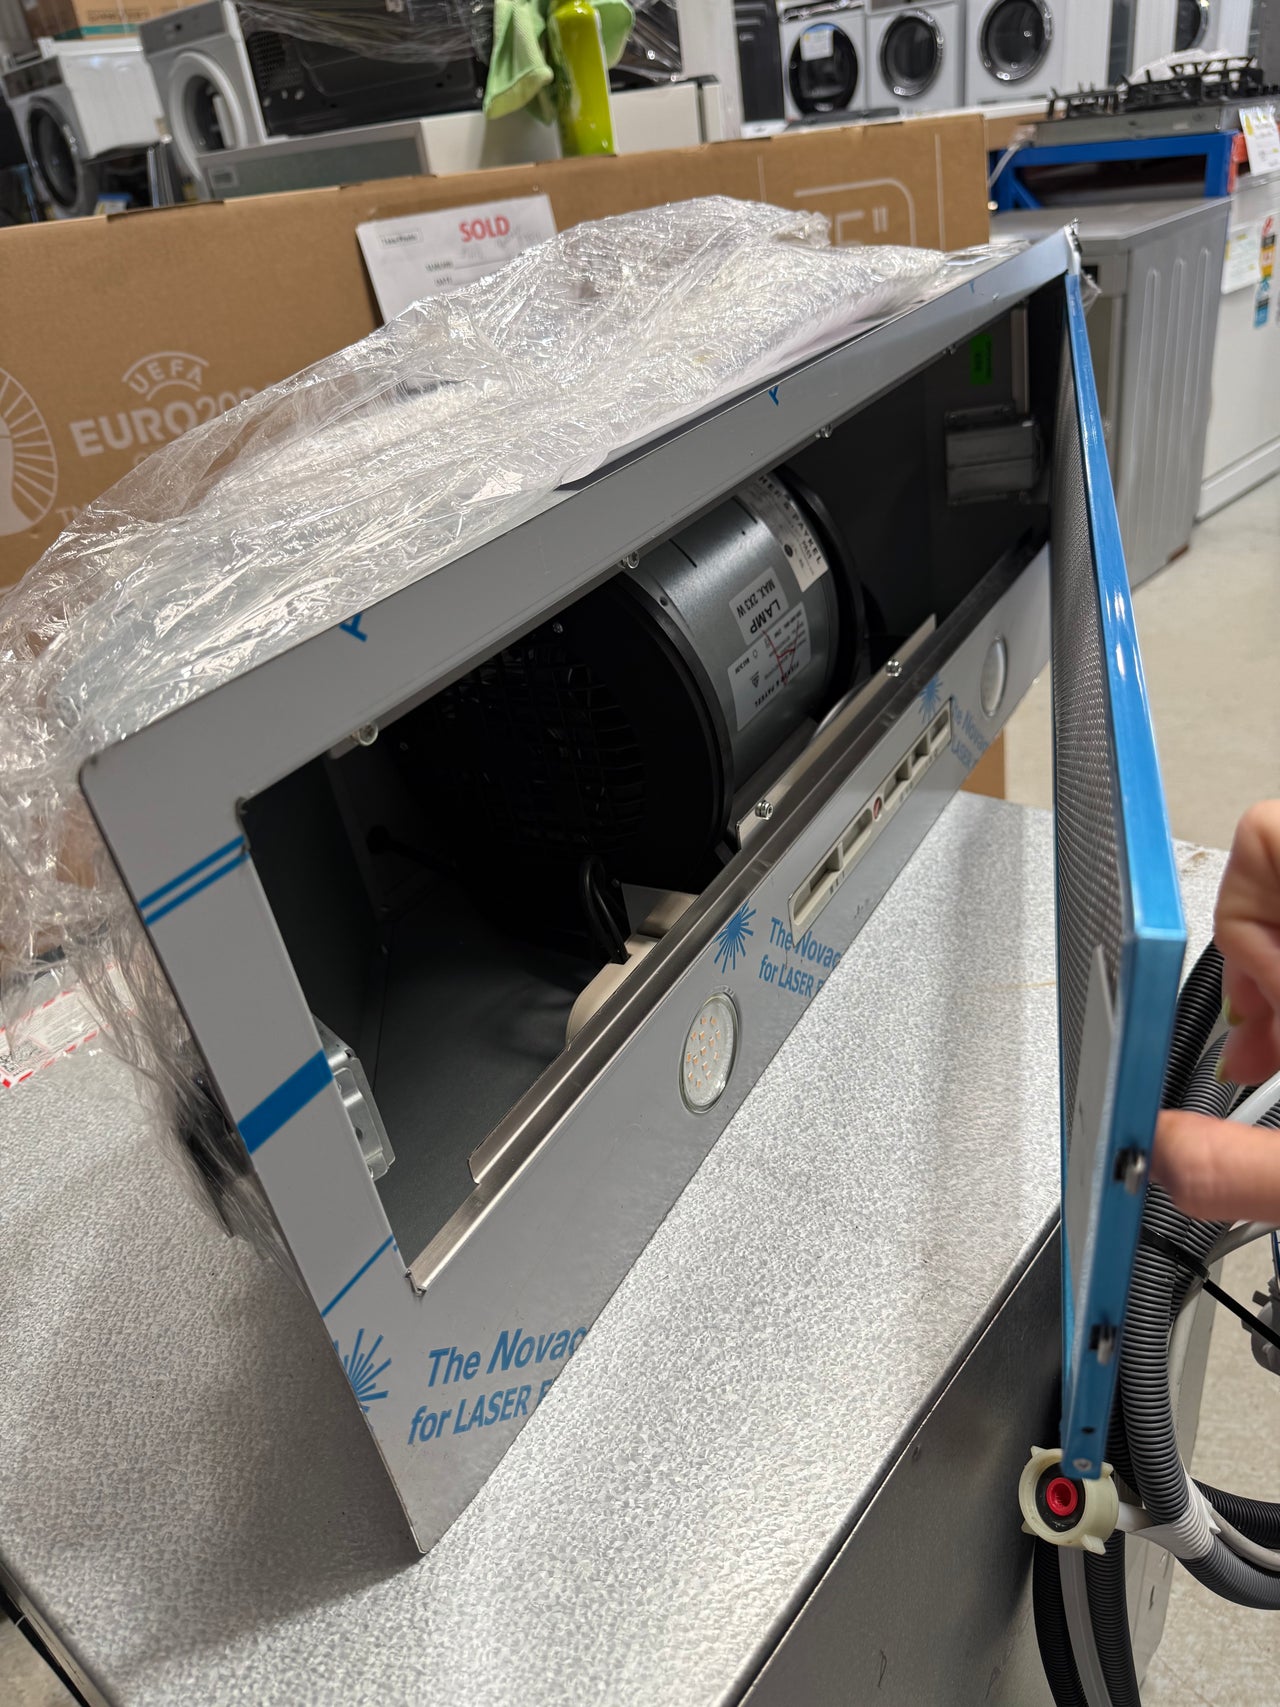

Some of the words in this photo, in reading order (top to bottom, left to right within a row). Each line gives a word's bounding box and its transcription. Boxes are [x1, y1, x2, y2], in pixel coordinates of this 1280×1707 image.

[458, 214, 511, 243] SOLD
[128, 359, 203, 394] UEFA
[750, 598, 781, 635] LAMP
[769, 916, 794, 951] The
[758, 954, 779, 984] for
[777, 963, 815, 999] LASER
[427, 1346, 482, 1388] The
[407, 1404, 453, 1446] for
[452, 1383, 532, 1435] LASER
